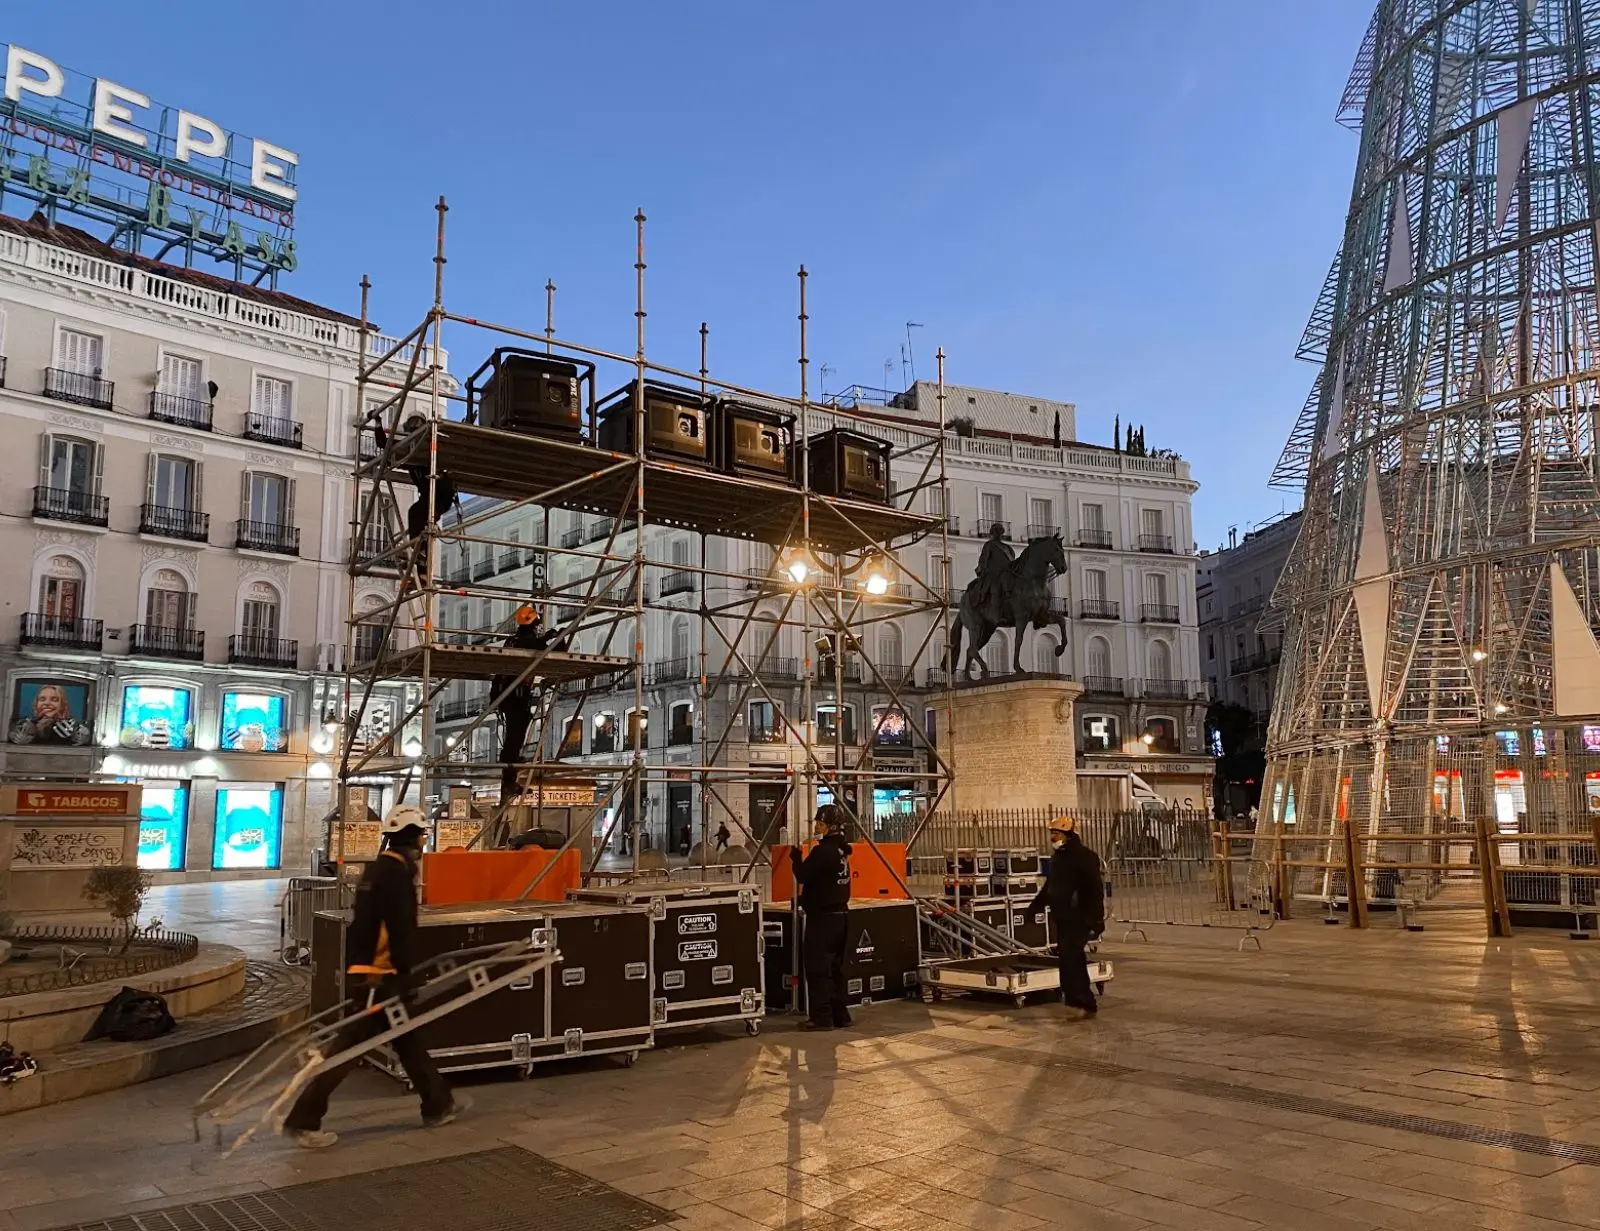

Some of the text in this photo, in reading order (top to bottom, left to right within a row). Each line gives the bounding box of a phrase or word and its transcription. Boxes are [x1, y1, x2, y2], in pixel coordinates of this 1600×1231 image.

[5, 43, 299, 202] PEPE
[148, 183, 298, 273] BYASS
[124, 764, 187, 778] SEPHORA
[52, 796, 120, 807] TABACOS
[549, 792, 577, 801] TICKETS
[684, 916, 712, 924] CAUTION
